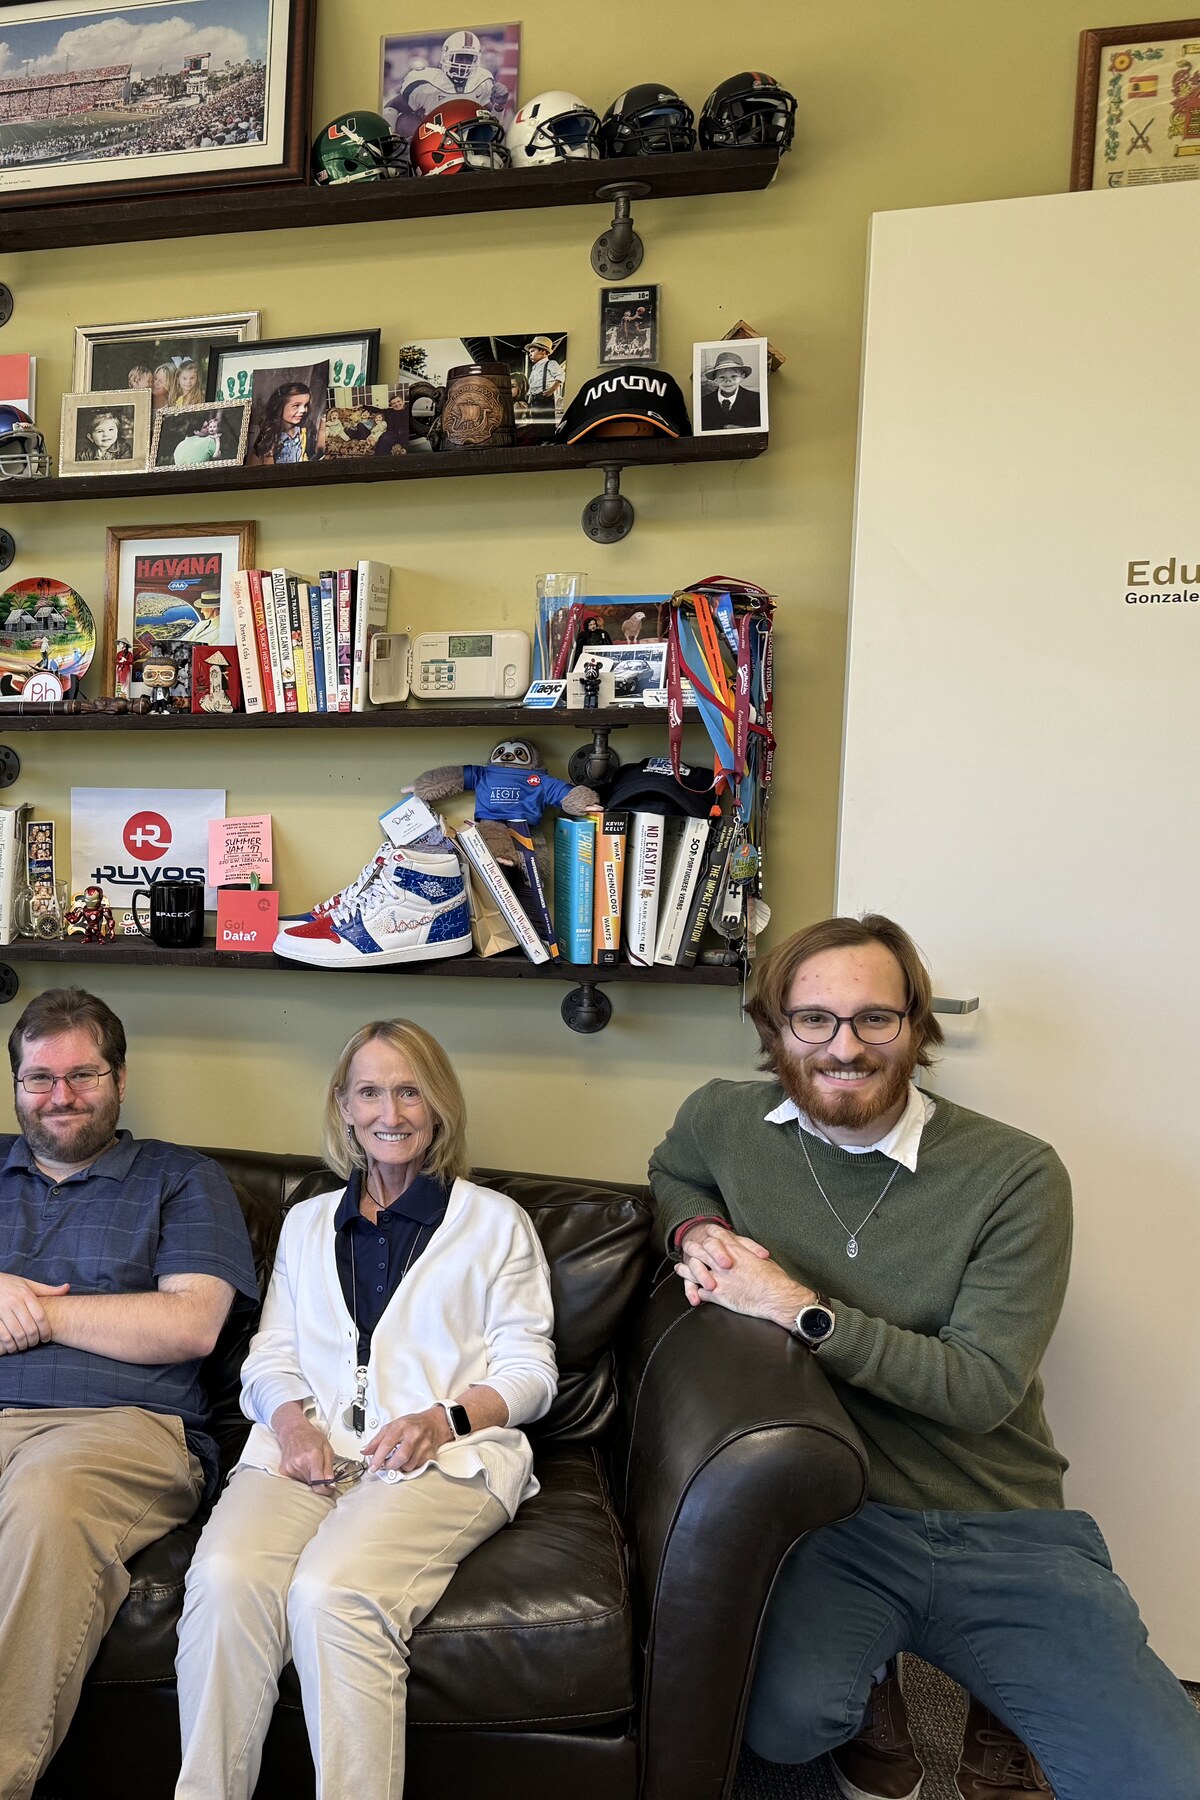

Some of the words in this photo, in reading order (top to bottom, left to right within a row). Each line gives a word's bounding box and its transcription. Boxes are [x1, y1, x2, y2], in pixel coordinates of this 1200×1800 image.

[137, 556, 219, 577] HAVANA
[1127, 557, 1200, 586] Edu
[1125, 590, 1200, 604] Gonzale
[254, 601, 264, 626] CUBA
[274, 573, 283, 609] ARIZONA
[281, 638, 290, 661] CANYON
[291, 600, 299, 628] TRAVELER
[324, 602, 333, 646] VIETNAM
[718, 610, 730, 634] TIME
[313, 630, 321, 651] STYLE
[727, 634, 737, 651] LIFE
[530, 683, 562, 695] flaeyc
[490, 790, 520, 798] AEGIS
[225, 837, 262, 847] SUMMER
[647, 826, 659, 837] NO
[248, 845, 259, 853] '97
[578, 829, 592, 865] SPRINT
[645, 842, 658, 865] EASY
[643, 869, 656, 887] DAY
[681, 857, 694, 892] PORTUGUESE
[710, 864, 721, 878] THE
[606, 863, 619, 914] TECHNOLOGY
[702, 880, 717, 907] IMPACT
[486, 862, 497, 876] The
[518, 914, 534, 944] Workout
[676, 891, 685, 910] VERBS
[156, 909, 196, 918] SPACEX
[223, 930, 257, 941] Data?
[224, 920, 245, 930] Got
[691, 908, 708, 942] EQUATION
